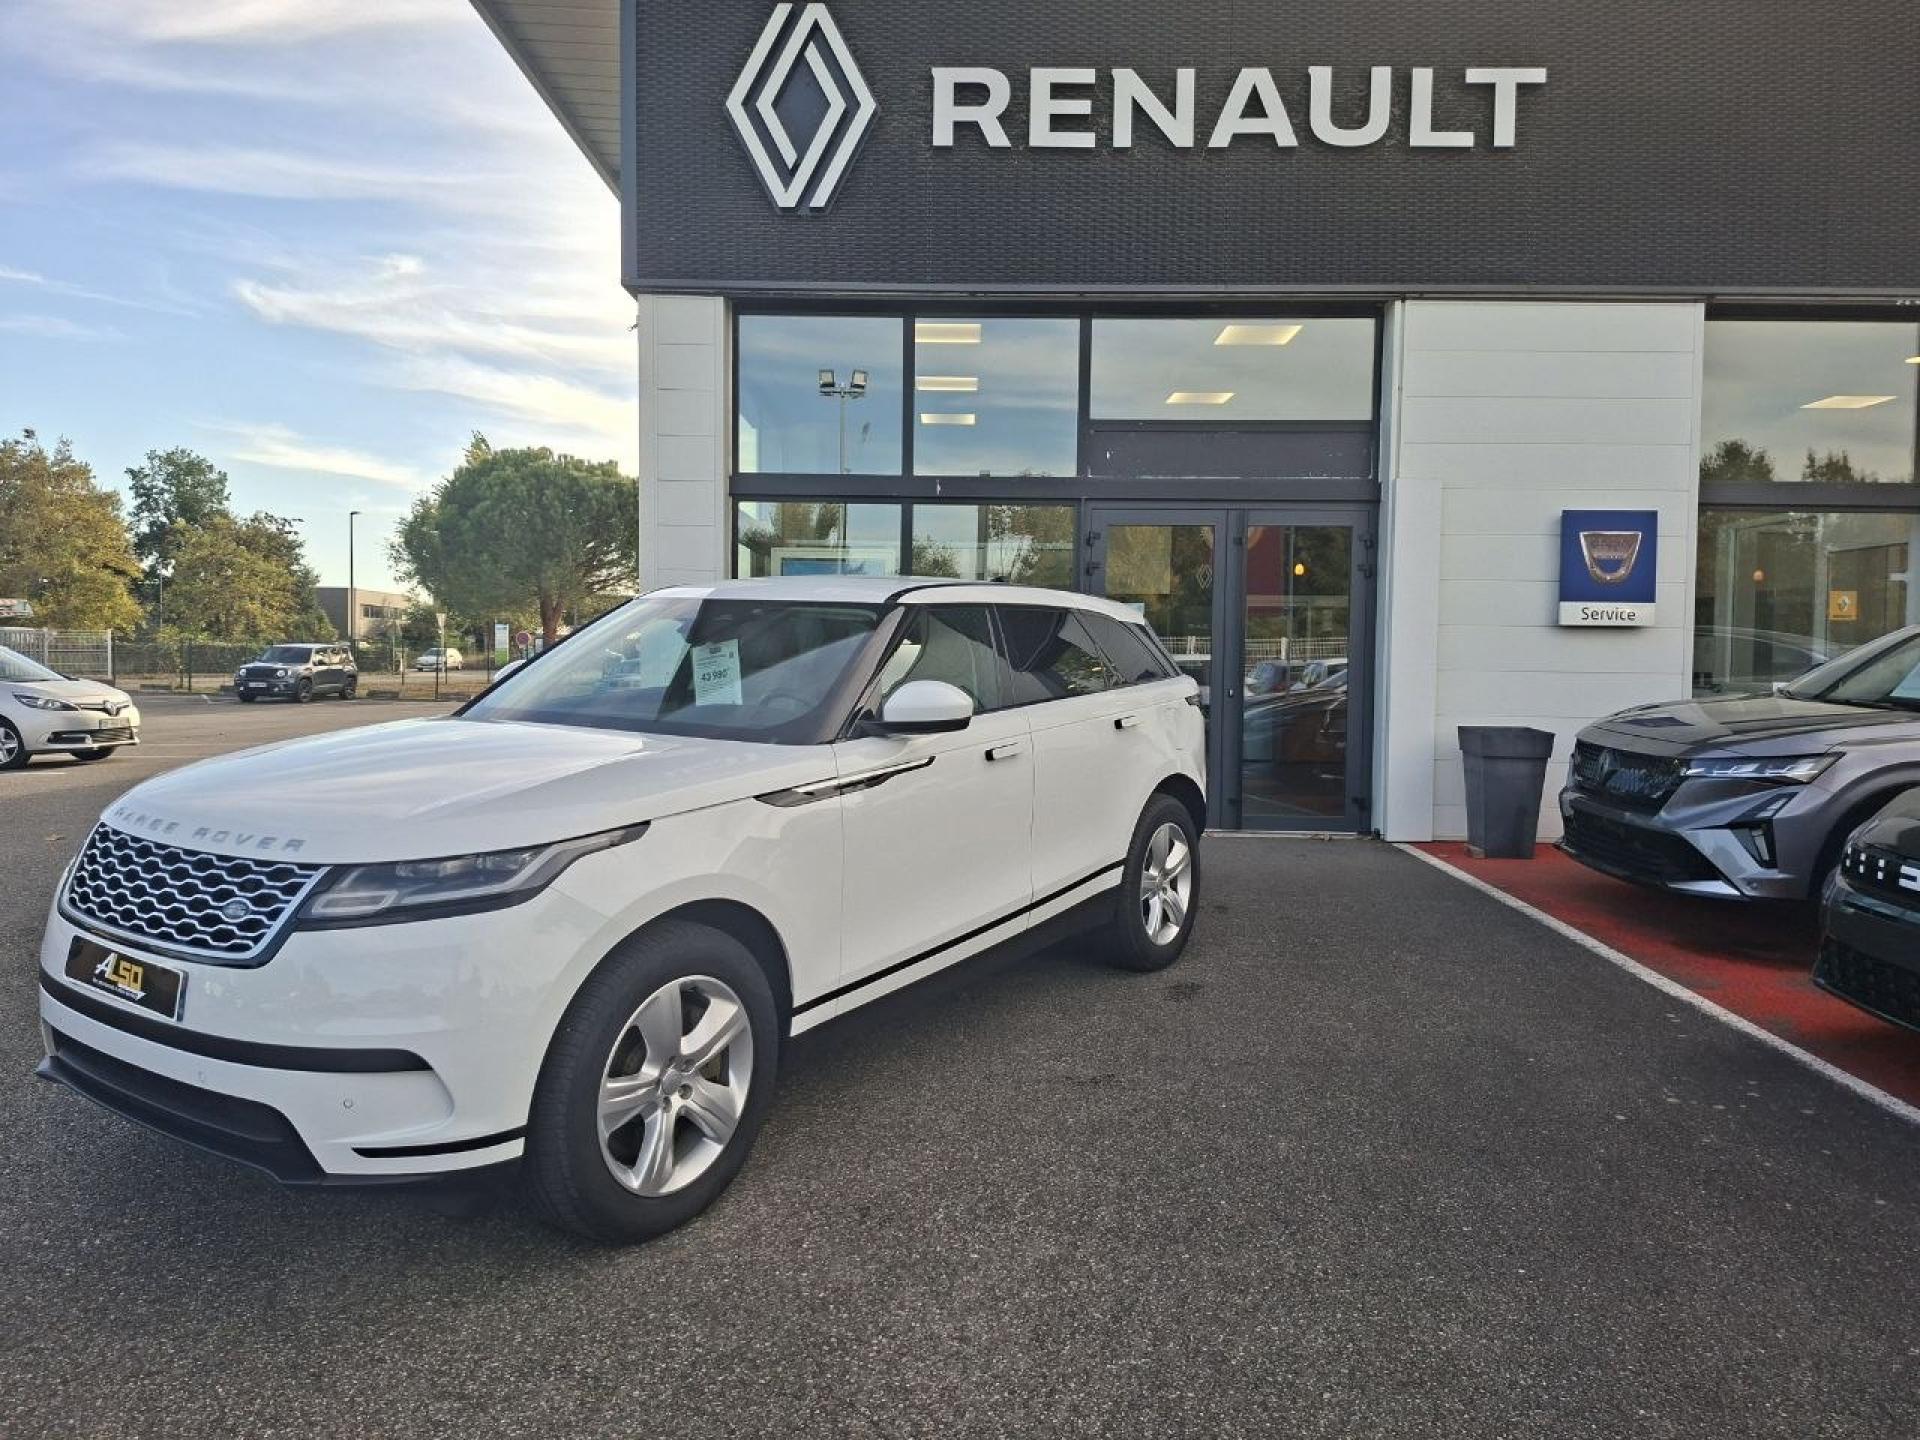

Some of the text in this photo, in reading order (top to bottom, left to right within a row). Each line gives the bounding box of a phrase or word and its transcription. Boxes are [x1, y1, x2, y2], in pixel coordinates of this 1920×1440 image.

[931, 65, 1548, 148] RENAULT
[1581, 607, 1636, 621] Service
[192, 827, 307, 852] ROVER
